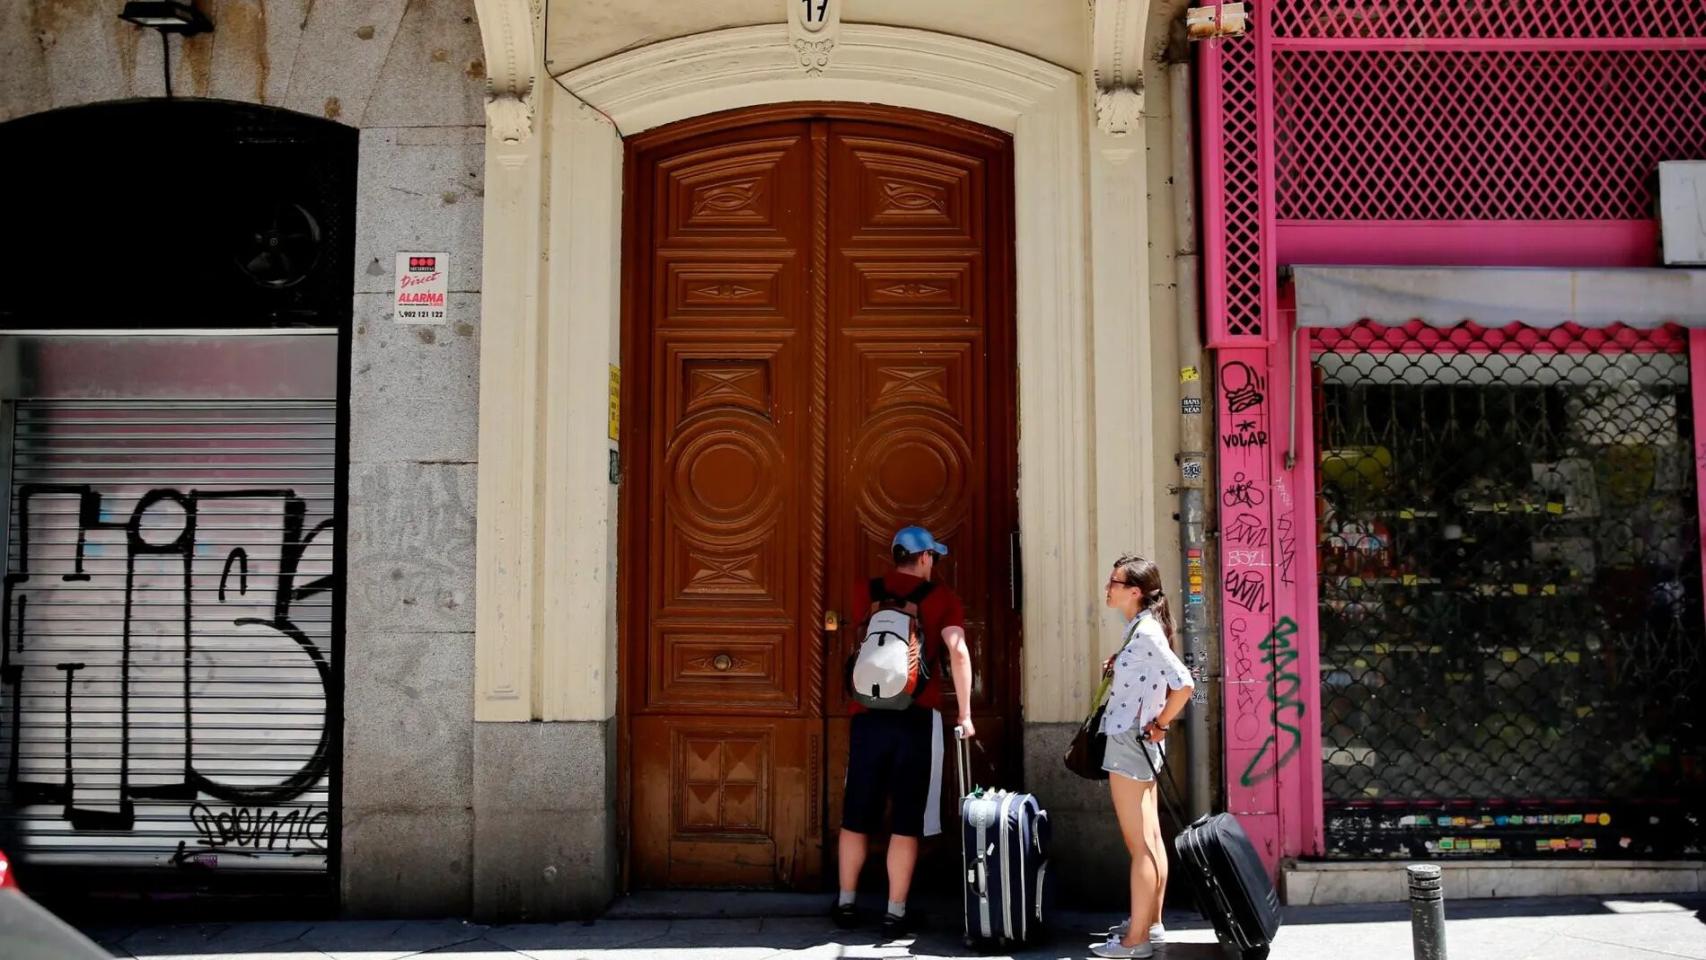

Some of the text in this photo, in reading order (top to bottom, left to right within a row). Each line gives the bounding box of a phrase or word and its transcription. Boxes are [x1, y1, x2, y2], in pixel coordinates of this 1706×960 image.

[802, 0, 829, 22] 17
[398, 293, 444, 303] ALARMA
[1222, 431, 1268, 448] VOLAR
